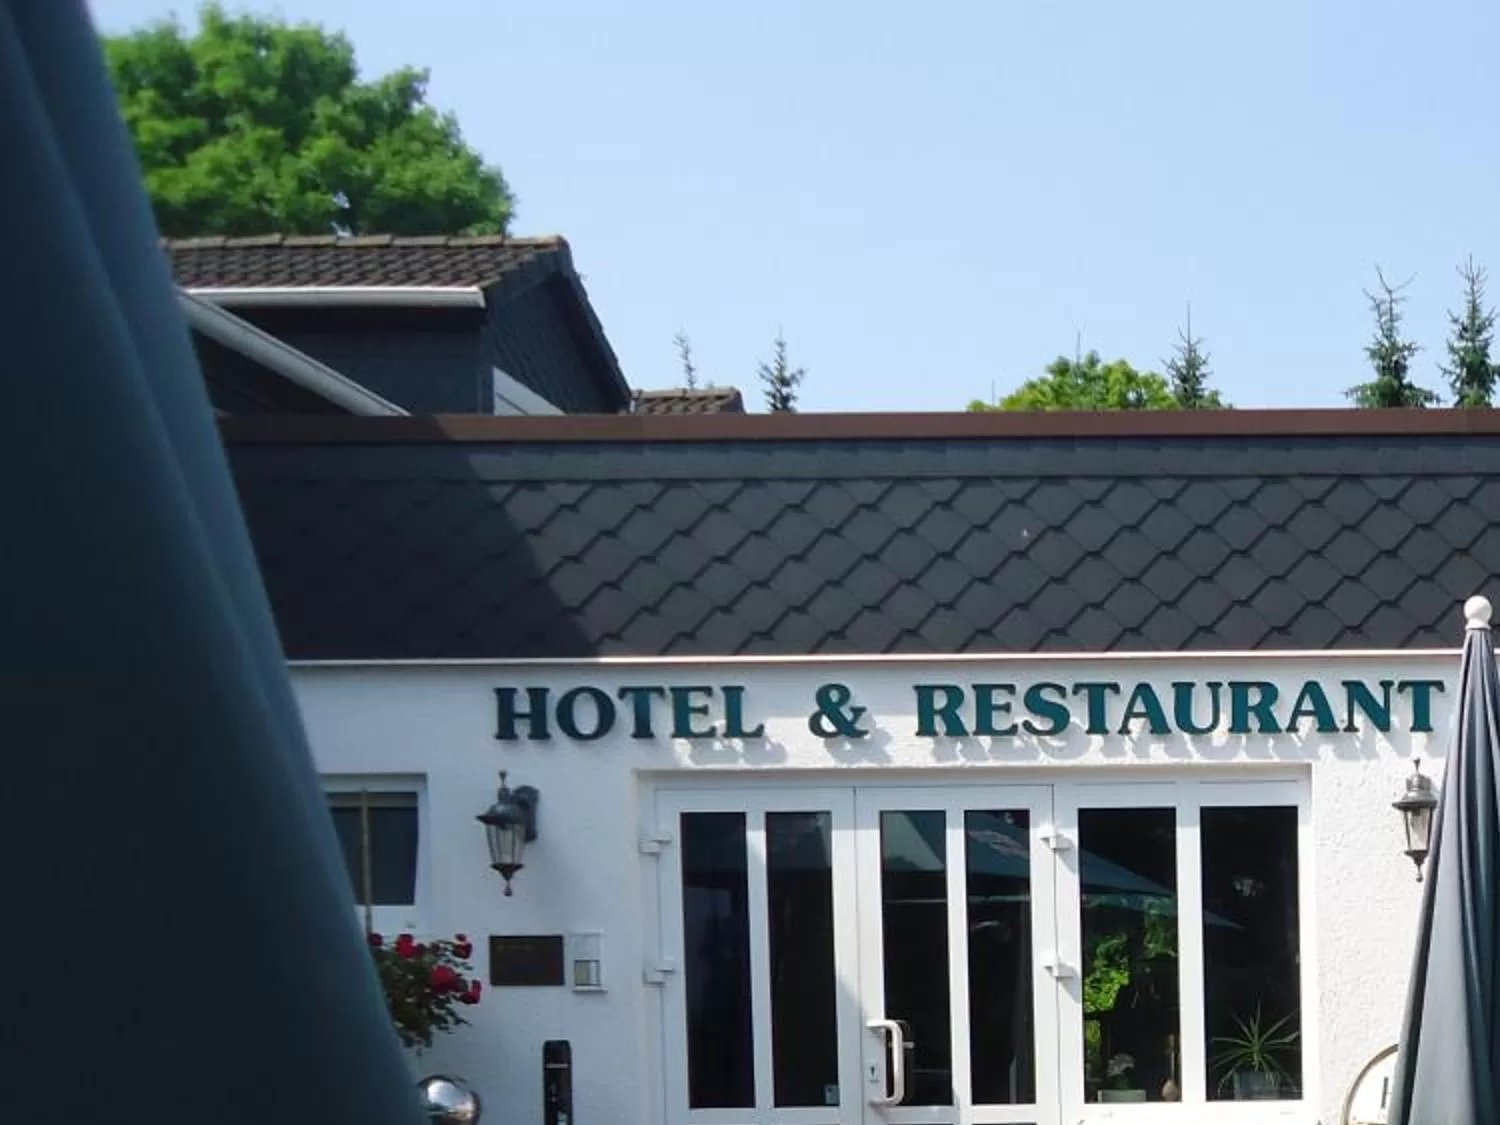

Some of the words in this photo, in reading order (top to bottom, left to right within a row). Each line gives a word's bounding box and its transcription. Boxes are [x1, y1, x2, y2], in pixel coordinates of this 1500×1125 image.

[494, 686, 764, 740] HOTEL
[808, 683, 869, 739] &
[914, 680, 1444, 738] RESTAURANT
